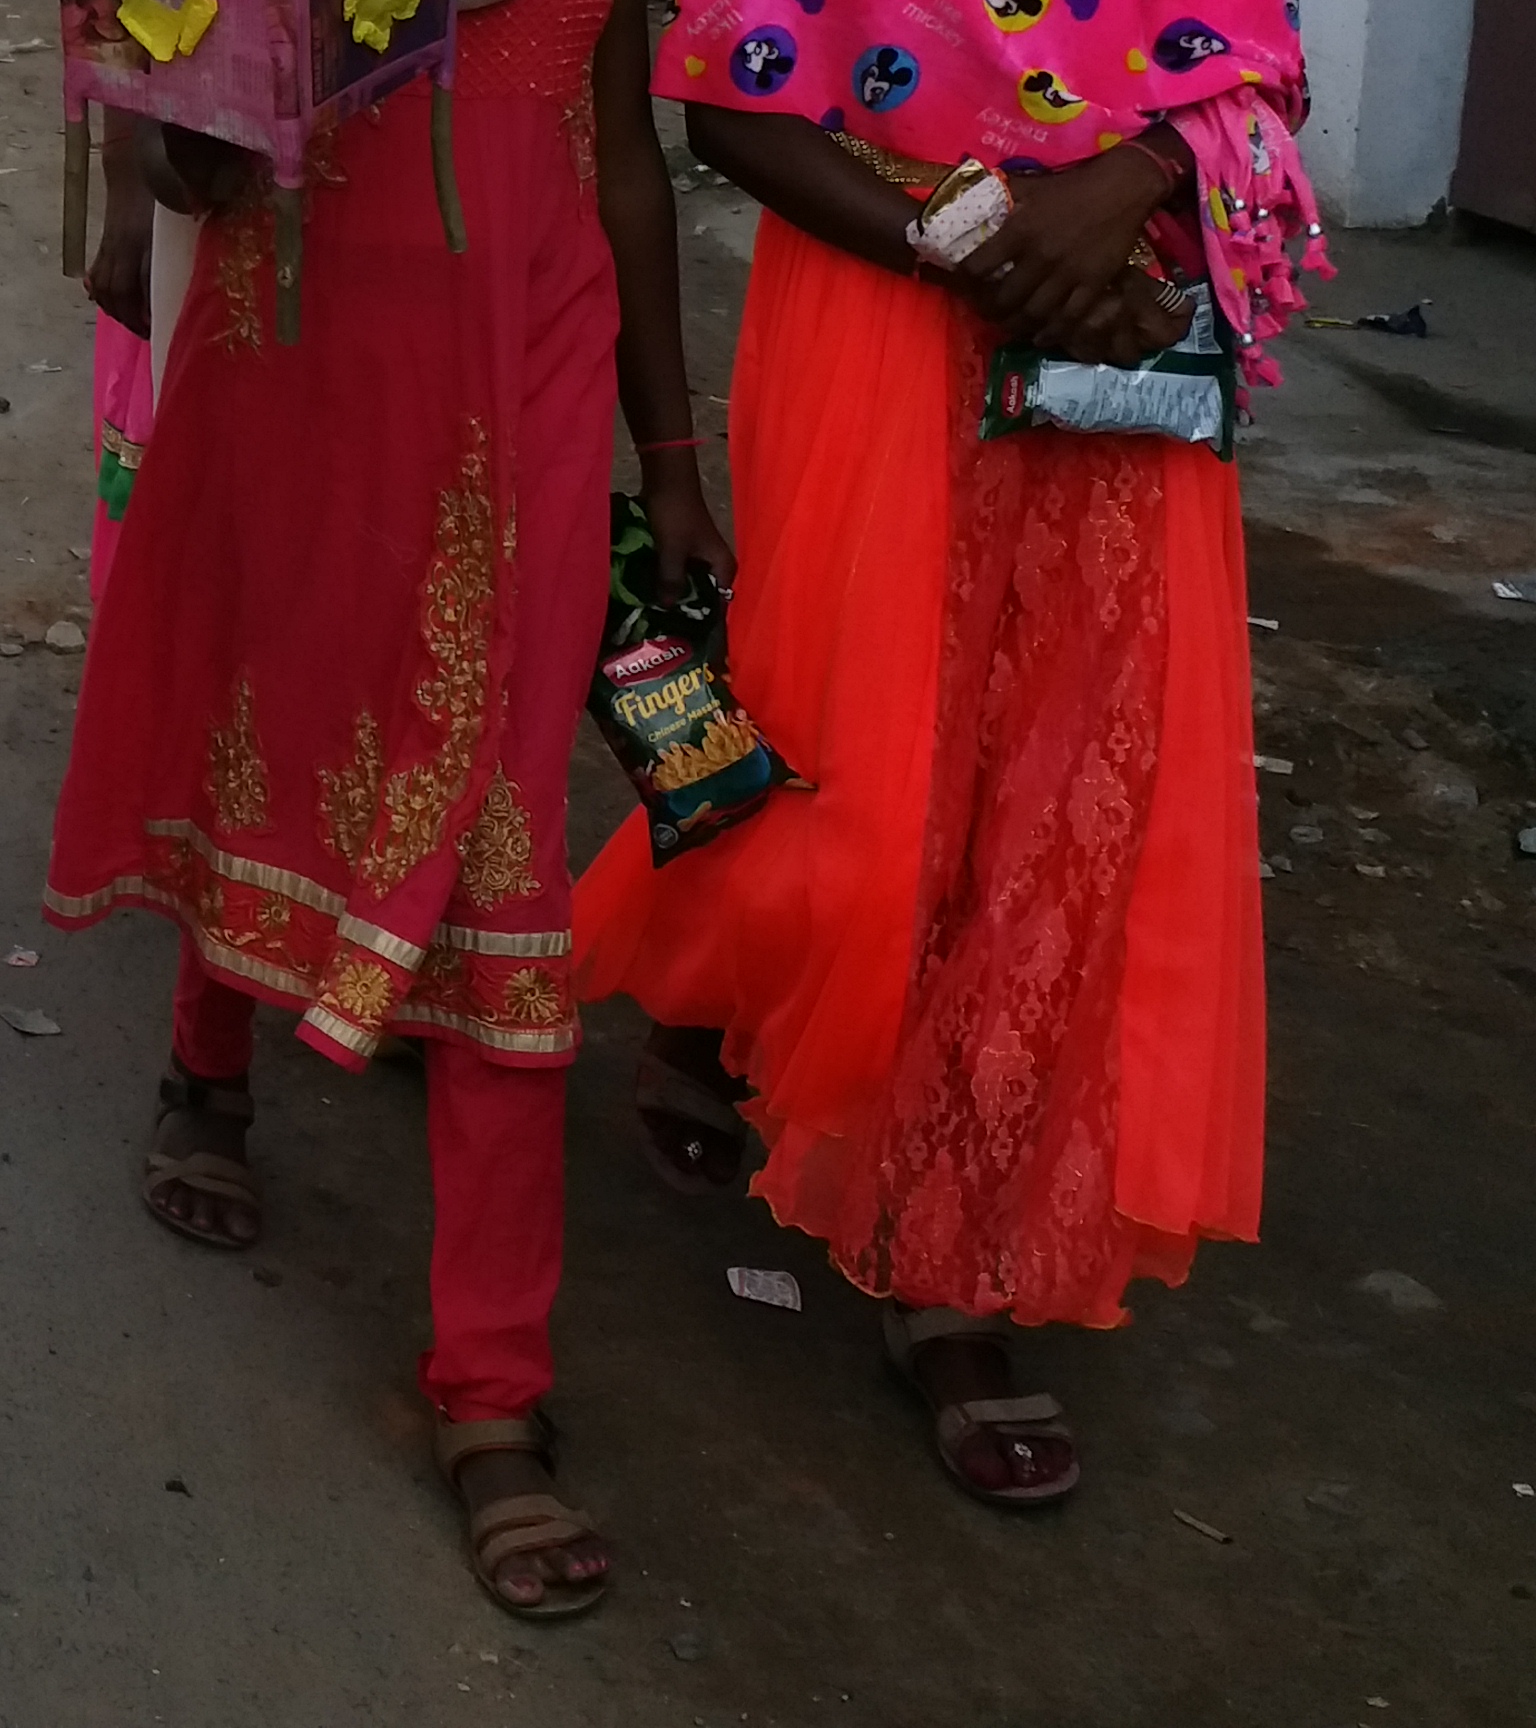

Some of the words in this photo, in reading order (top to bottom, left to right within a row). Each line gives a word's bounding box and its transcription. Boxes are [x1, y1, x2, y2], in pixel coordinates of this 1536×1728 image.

[978, 105, 1049, 145] mickey
[1006, 375, 1019, 414] Aakash
[614, 644, 686, 680] Aakash
[614, 662, 716, 728] Fingers
